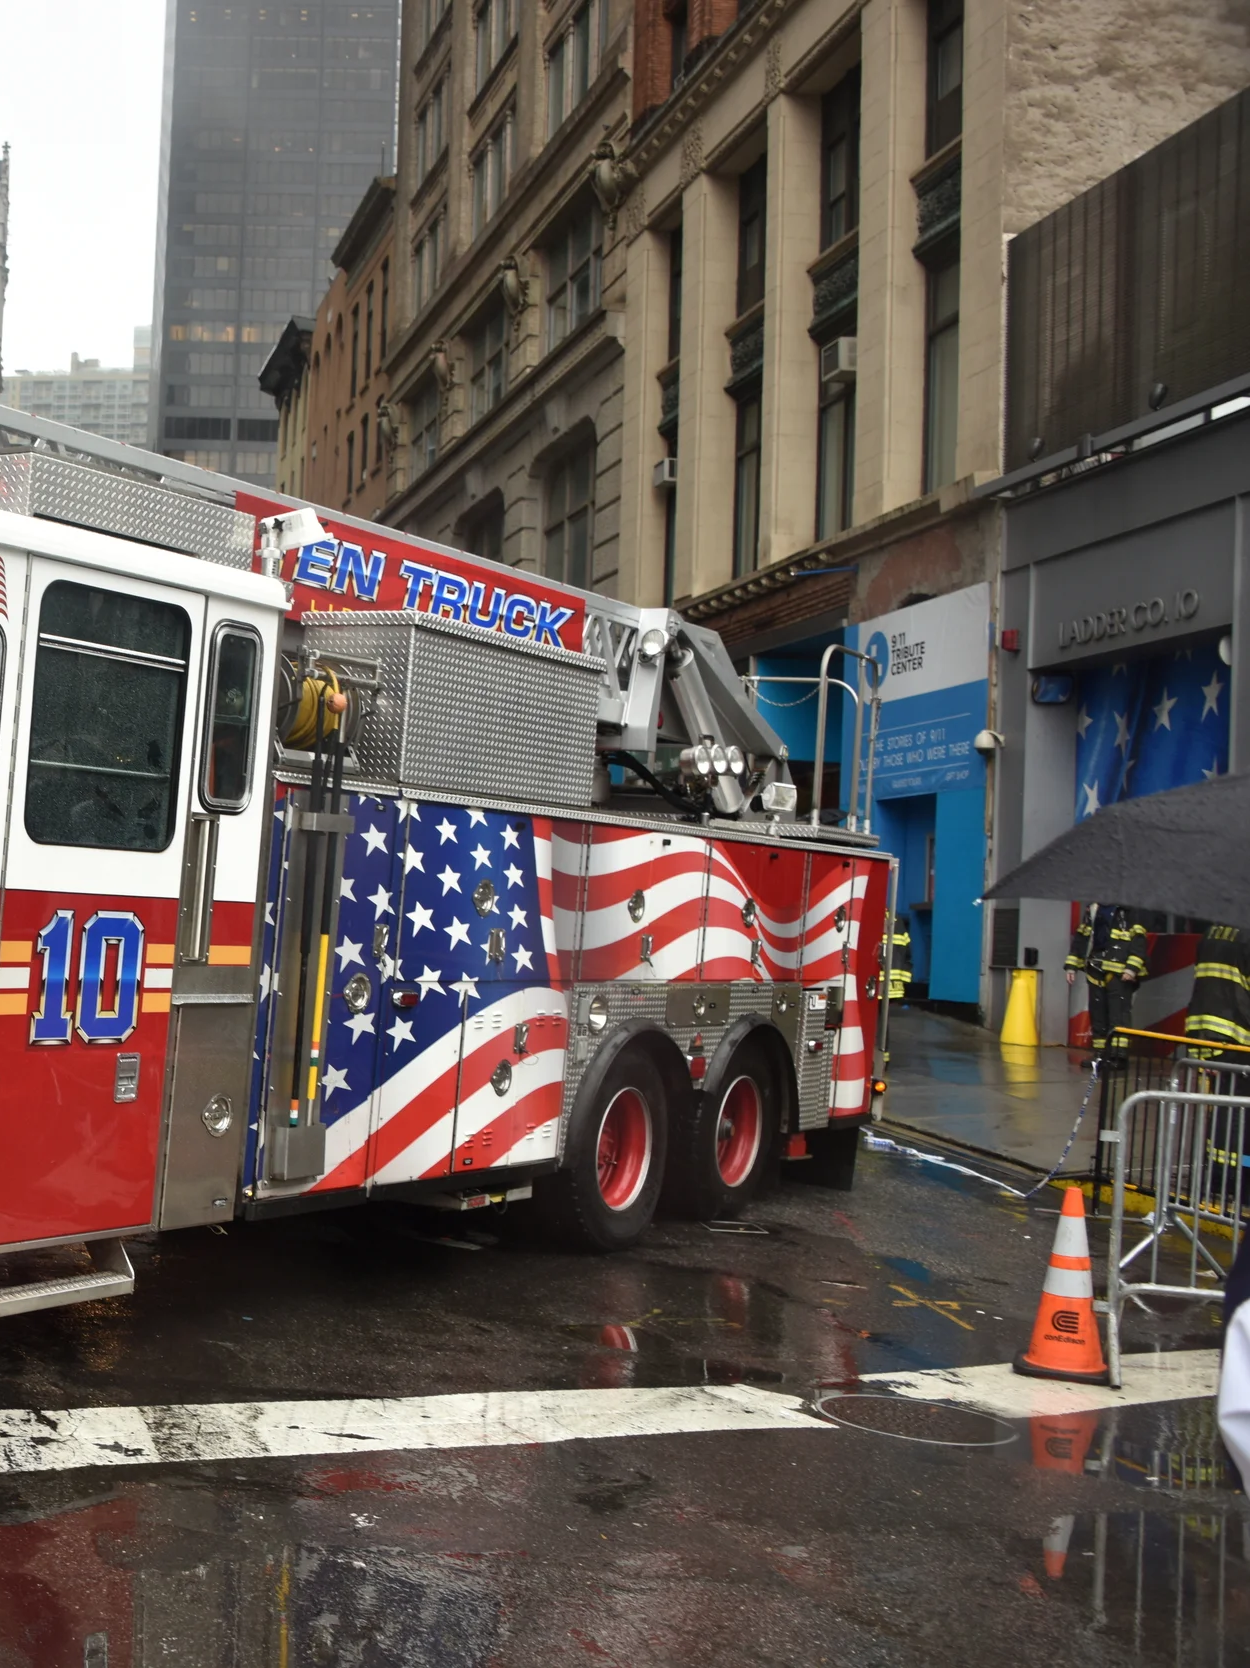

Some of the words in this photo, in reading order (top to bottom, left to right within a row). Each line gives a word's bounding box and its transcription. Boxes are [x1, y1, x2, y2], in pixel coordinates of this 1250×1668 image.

[279, 538, 387, 602] EN
[399, 558, 575, 648] TRUCK
[1059, 607, 1126, 649] LADDER
[1132, 596, 1168, 631] CO.
[891, 641, 926, 662] TRIBUTE
[891, 656, 923, 676] CENTER
[906, 749, 924, 764] WHO
[926, 745, 946, 760] WERE
[29, 909, 145, 1045] 10
